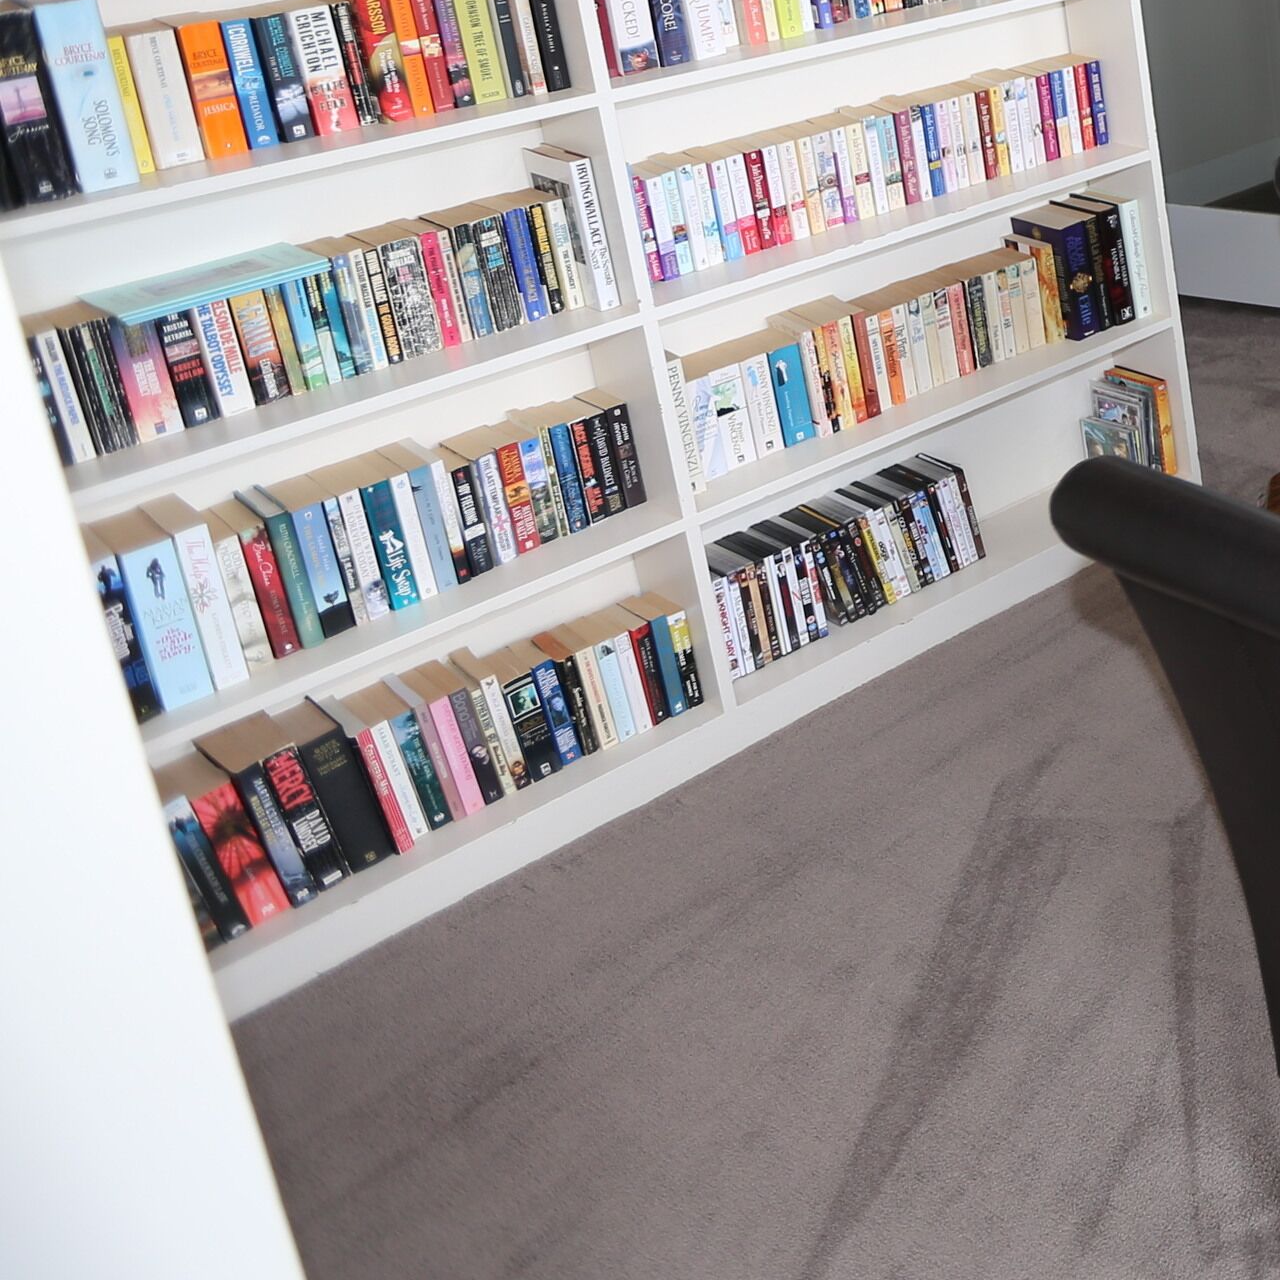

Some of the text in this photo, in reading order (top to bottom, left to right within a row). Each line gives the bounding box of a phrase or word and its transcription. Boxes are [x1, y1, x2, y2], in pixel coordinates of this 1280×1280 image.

[64, 43, 94, 57] BRYCE
[228, 27, 256, 75] CORNWELL
[295, 15, 322, 73] CRICHTON
[311, 12, 338, 71] MICHAEL
[472, 31, 484, 47] TREE
[476, 48, 486, 57] OF
[55, 50, 106, 66] COURTENAY
[479, 58, 493, 81] SMOKE
[311, 81, 345, 94] STATE
[204, 103, 235, 115] JESSICA
[249, 91, 265, 131] PREDATOR
[320, 100, 346, 111] FEAR
[82, 117, 101, 145] SONG
[576, 162, 602, 246] IRVING WALLACE
[1110, 247, 1121, 280] HANNIBAL
[371, 273, 388, 304] WALLACE
[1079, 295, 1091, 326] Exile
[164, 330, 192, 343] BETRAYAL
[220, 331, 231, 344] DE
[895, 323, 908, 360] The Pirate
[201, 317, 220, 352] TALBOT
[211, 354, 235, 398] ODYSSEY
[223, 344, 241, 374] MILLE
[756, 361, 768, 384] PENNY
[613, 423, 623, 446] IRVING
[621, 422, 630, 441] JOHN
[670, 366, 699, 475] PENNY VINCENZI
[482, 459, 493, 470] THE
[485, 470, 495, 484] LAST
[460, 495, 478, 525] FIELDING
[718, 602, 735, 660] KNIGHT DAY
[265, 753, 314, 812] MERCY
[307, 809, 331, 844] DAVID
